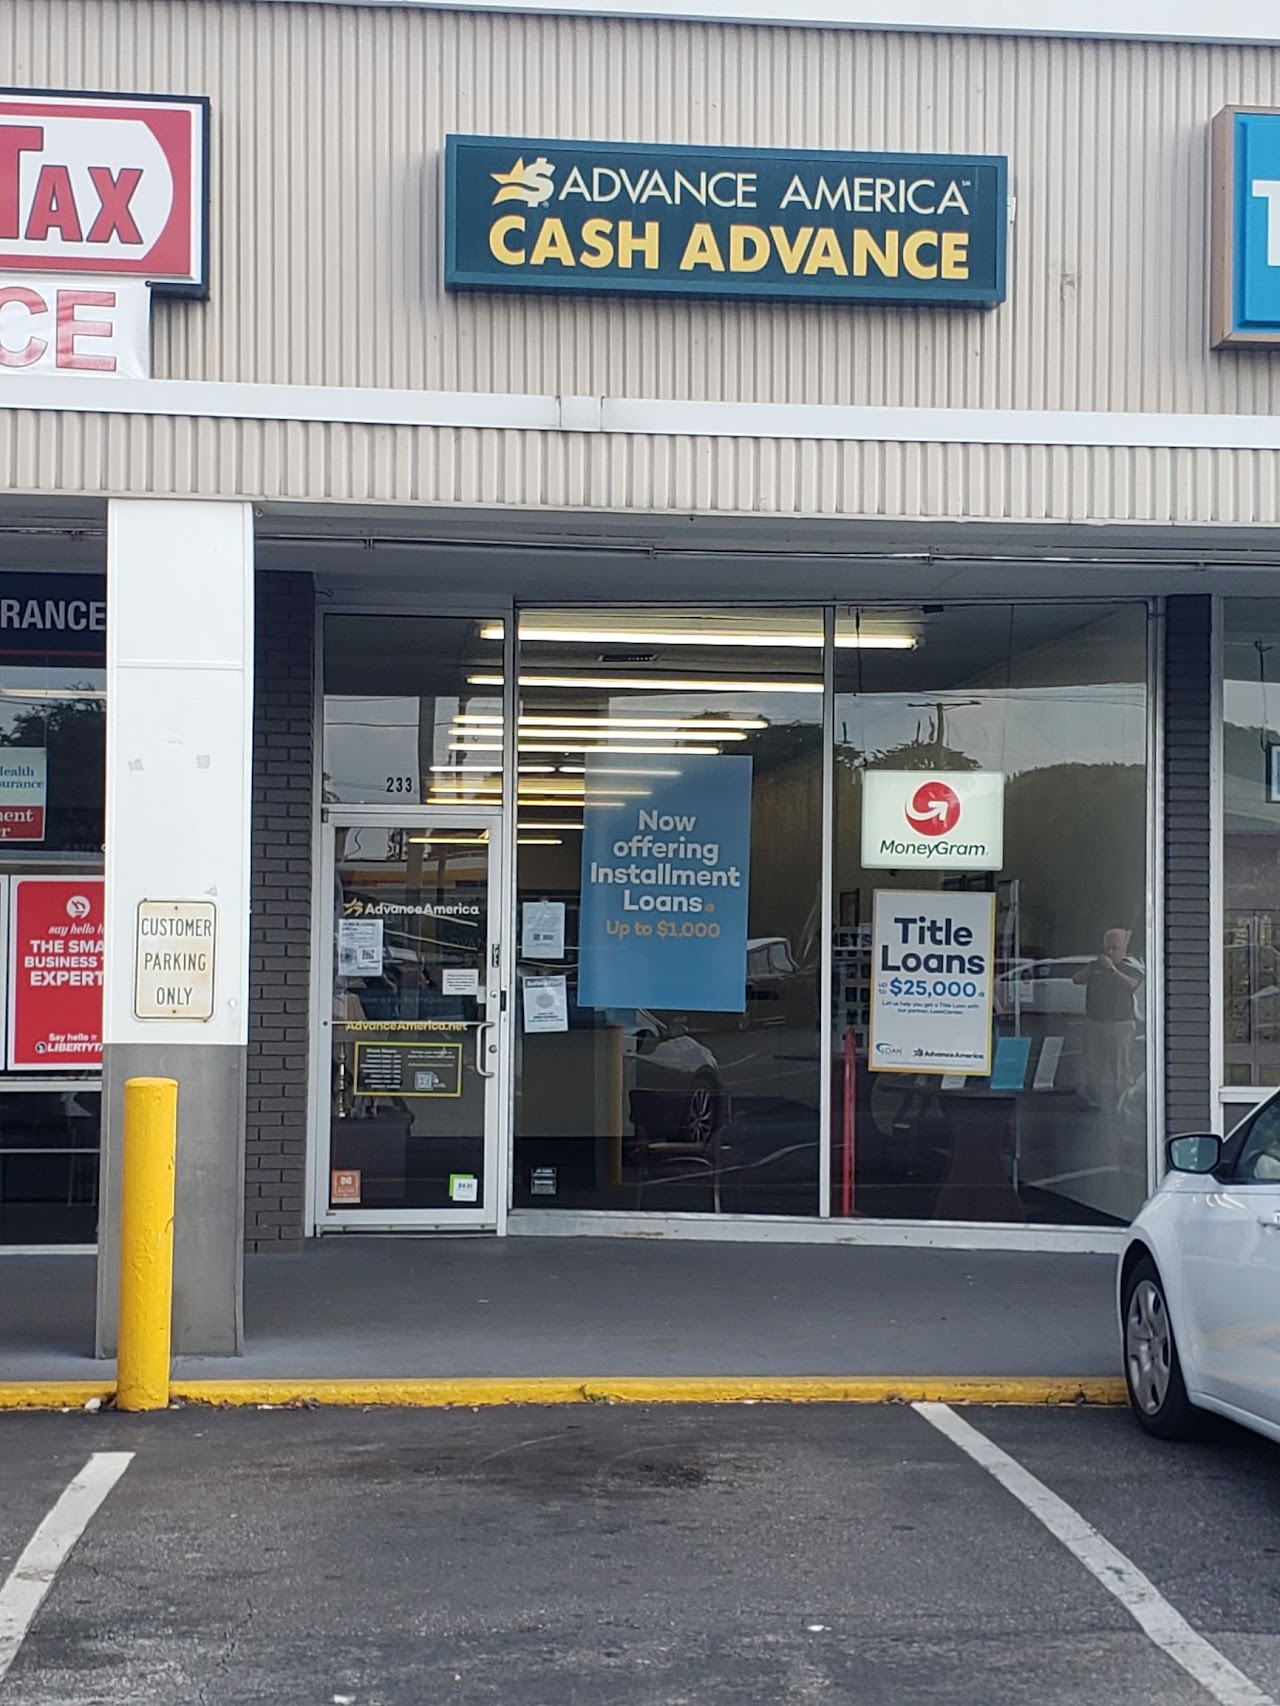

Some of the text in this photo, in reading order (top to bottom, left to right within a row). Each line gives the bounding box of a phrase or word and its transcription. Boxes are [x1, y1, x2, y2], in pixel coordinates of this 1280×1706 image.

[558, 167, 757, 208] ADVANCE
[779, 175, 970, 216] AMERICA
[488, 216, 970, 280] CASH ADVANCE
[386, 777, 413, 792] 233
[638, 809, 696, 832] Now
[613, 836, 719, 866] offering
[880, 840, 986, 859] MoneyGram
[590, 862, 741, 888] Installment
[364, 902, 480, 915] AdvanceAmerica
[623, 890, 703, 912] Loans
[48, 924, 68, 936] say
[71, 923, 94, 934] hello
[141, 917, 212, 937] CUSTOMER
[605, 920, 630, 939] Up
[634, 921, 652, 936] to
[894, 916, 973, 947] Title
[30, 940, 64, 953] THE
[24, 956, 98, 968] BUSINESS
[144, 952, 207, 971] PARKING
[881, 944, 985, 976] Loans
[156, 986, 193, 1005] ONLY
[889, 977, 977, 998] $25,000
[48, 1032, 65, 1043] Say
[67, 1032, 90, 1042] hello
